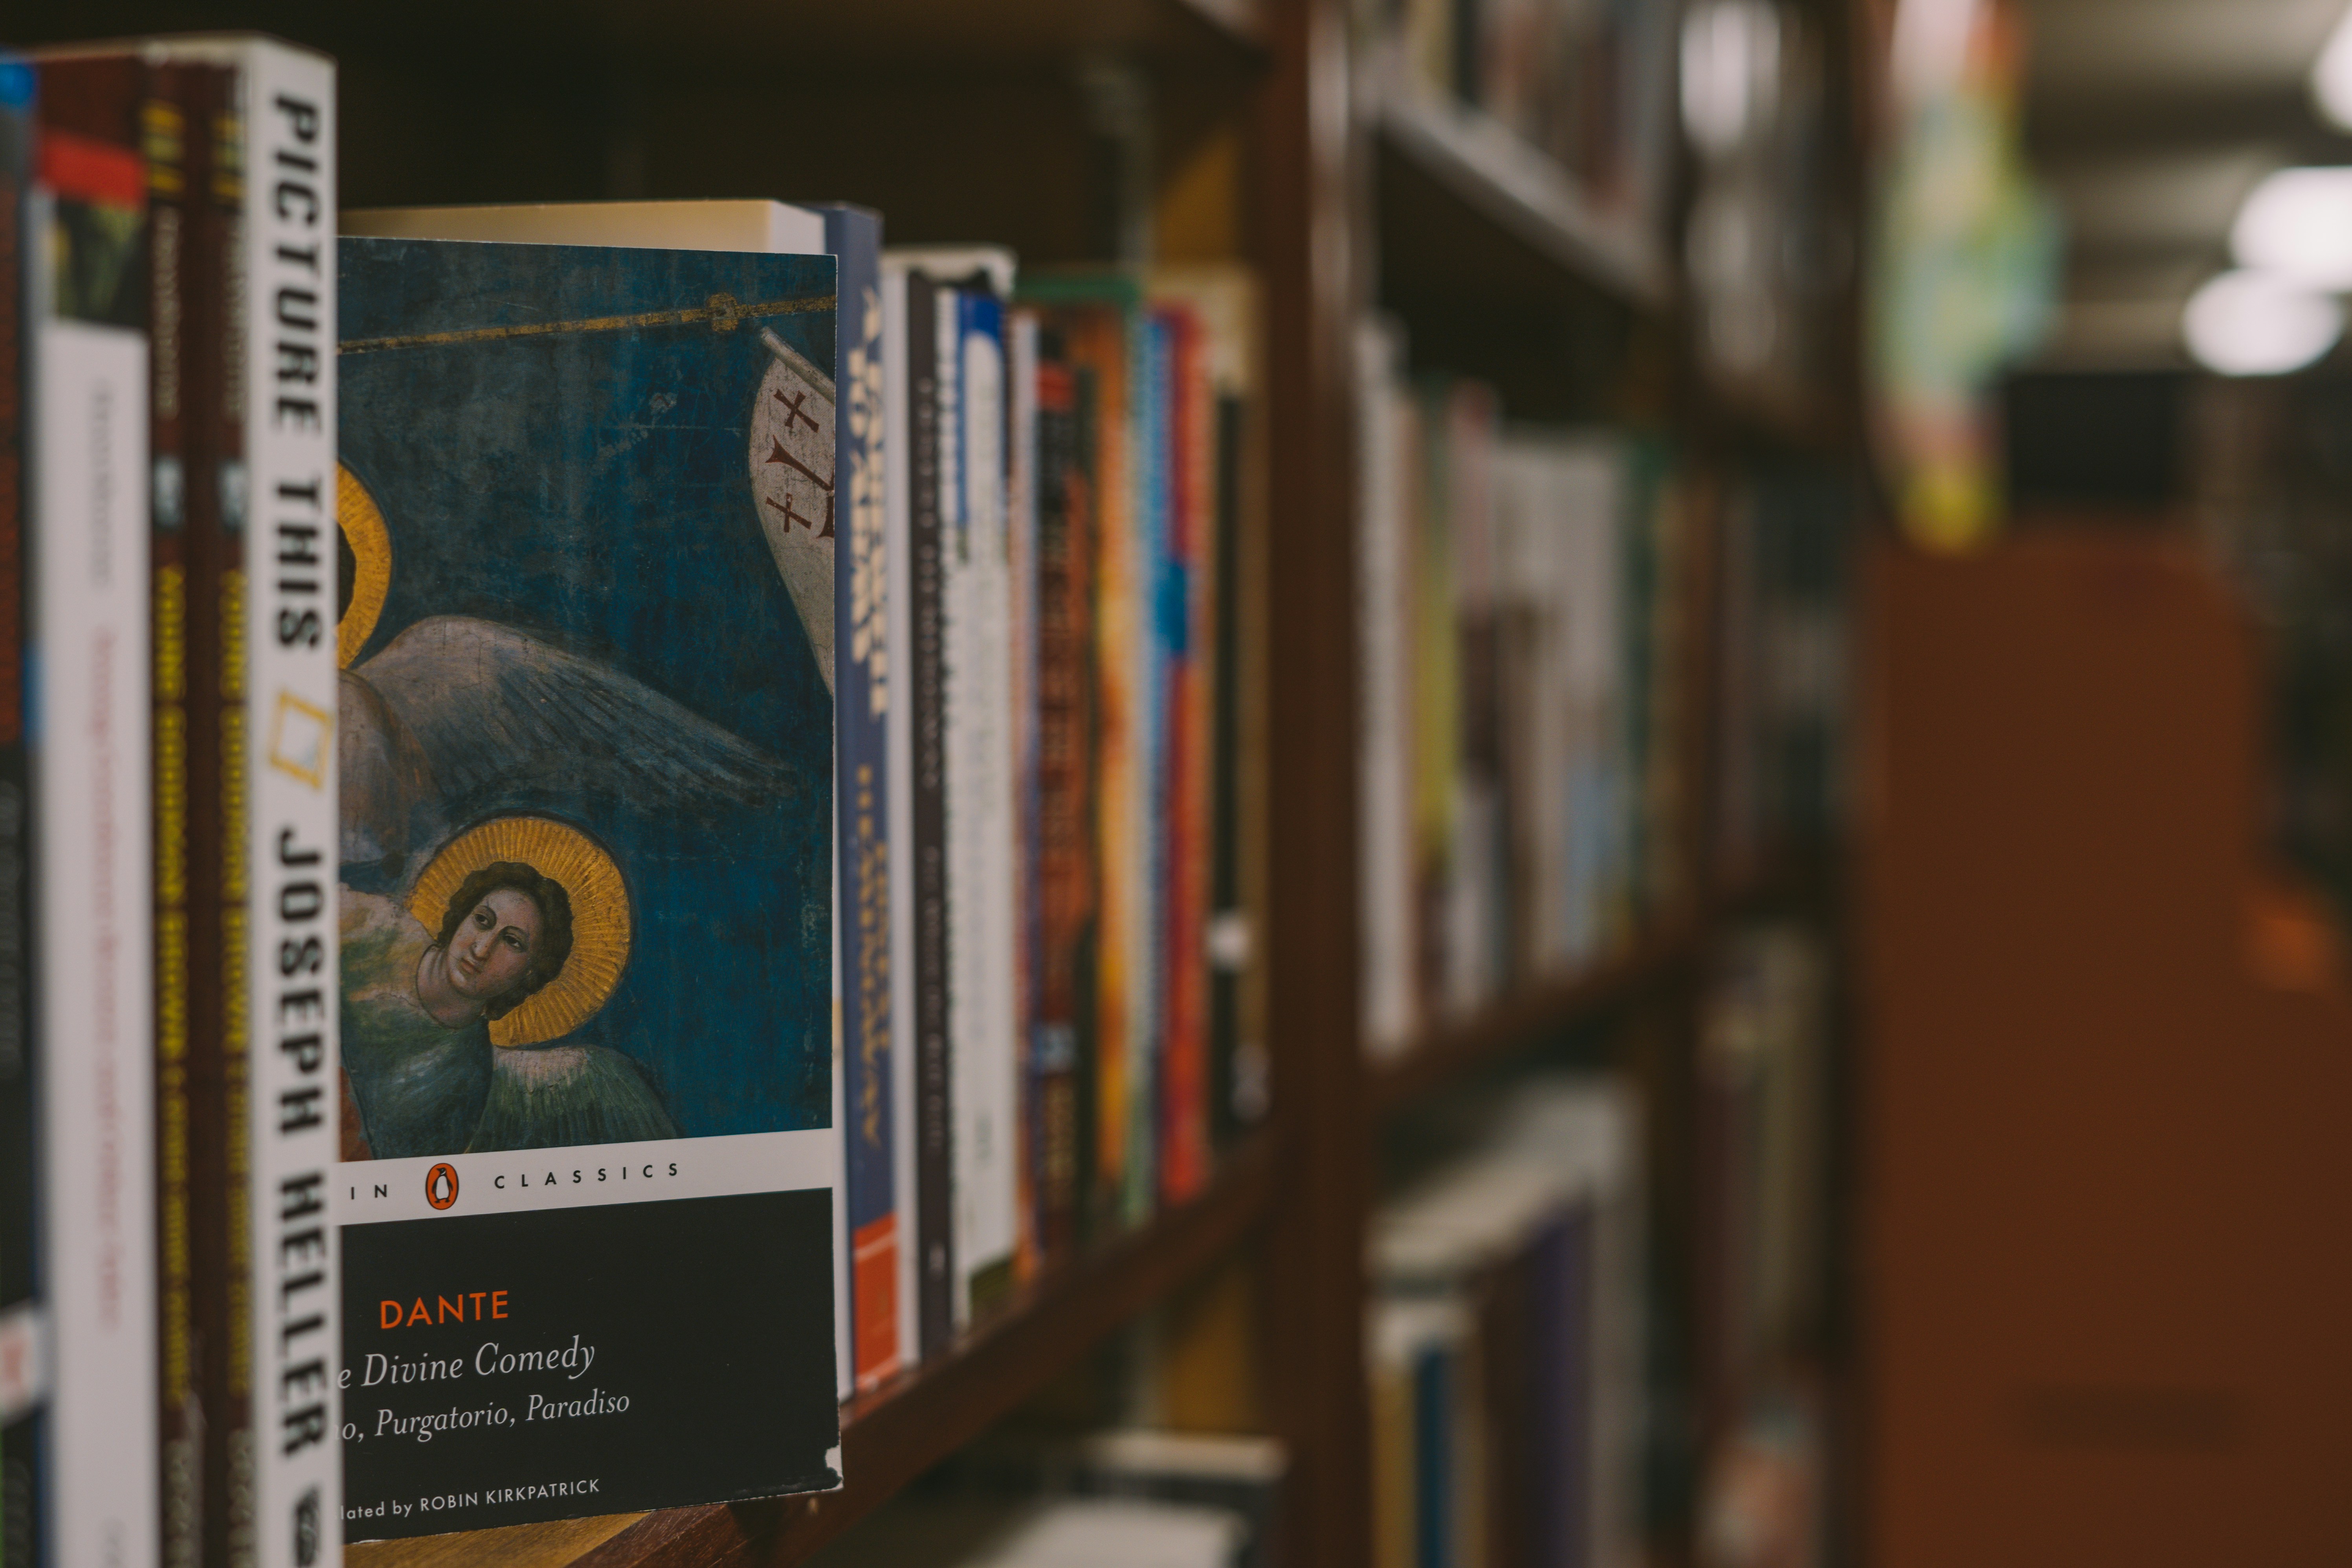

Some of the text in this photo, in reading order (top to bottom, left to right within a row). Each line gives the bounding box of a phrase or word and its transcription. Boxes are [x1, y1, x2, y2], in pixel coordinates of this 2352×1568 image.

[274, 93, 323, 650] PICTURE THIS
[278, 827, 328, 1458] JOSEPH HELLER
[494, 1163, 678, 1190] CLASSICS
[380, 1290, 509, 1330] DANTE
[361, 1352, 464, 1387] Divine
[475, 1334, 595, 1380] Comedy
[374, 1402, 516, 1443] Purgatorio,
[525, 1388, 630, 1421] Paradiso
[340, 1478, 600, 1520] lated by ROBIN KIRKPATRICK
